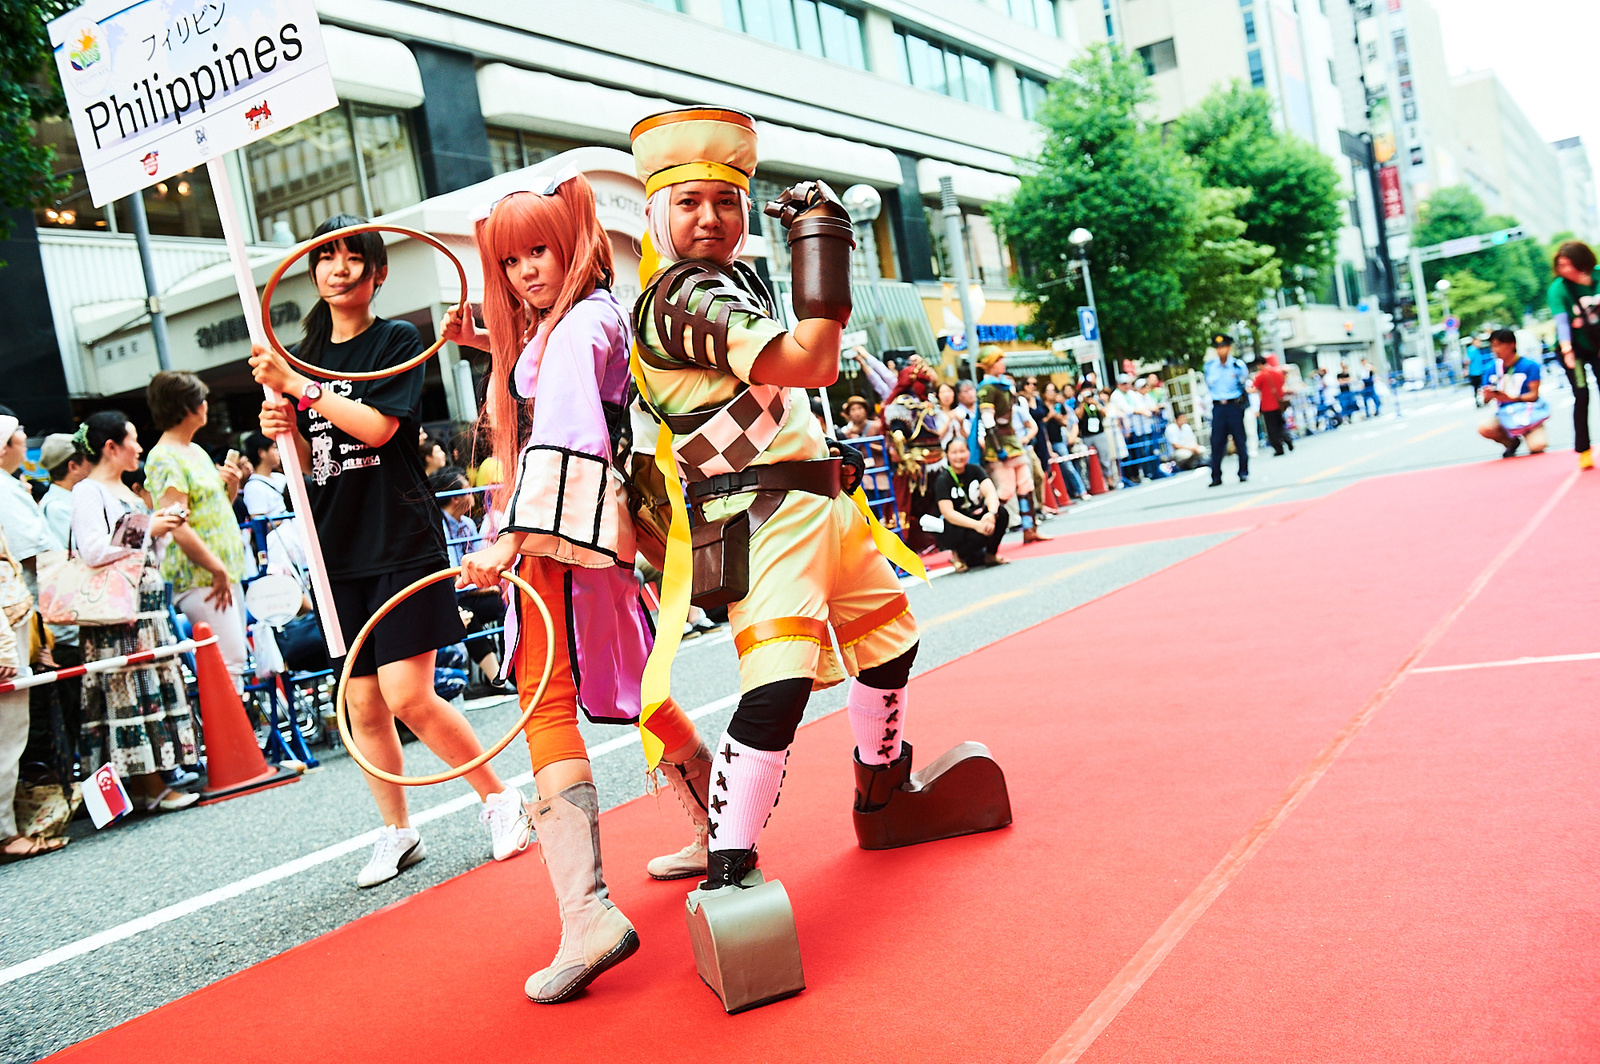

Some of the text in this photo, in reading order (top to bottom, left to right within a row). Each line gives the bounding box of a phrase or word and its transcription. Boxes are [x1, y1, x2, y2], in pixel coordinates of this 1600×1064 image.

[142, 2, 226, 62] フィリピン
[84, 23, 303, 150] Philippines
[1082, 310, 1095, 339] P
